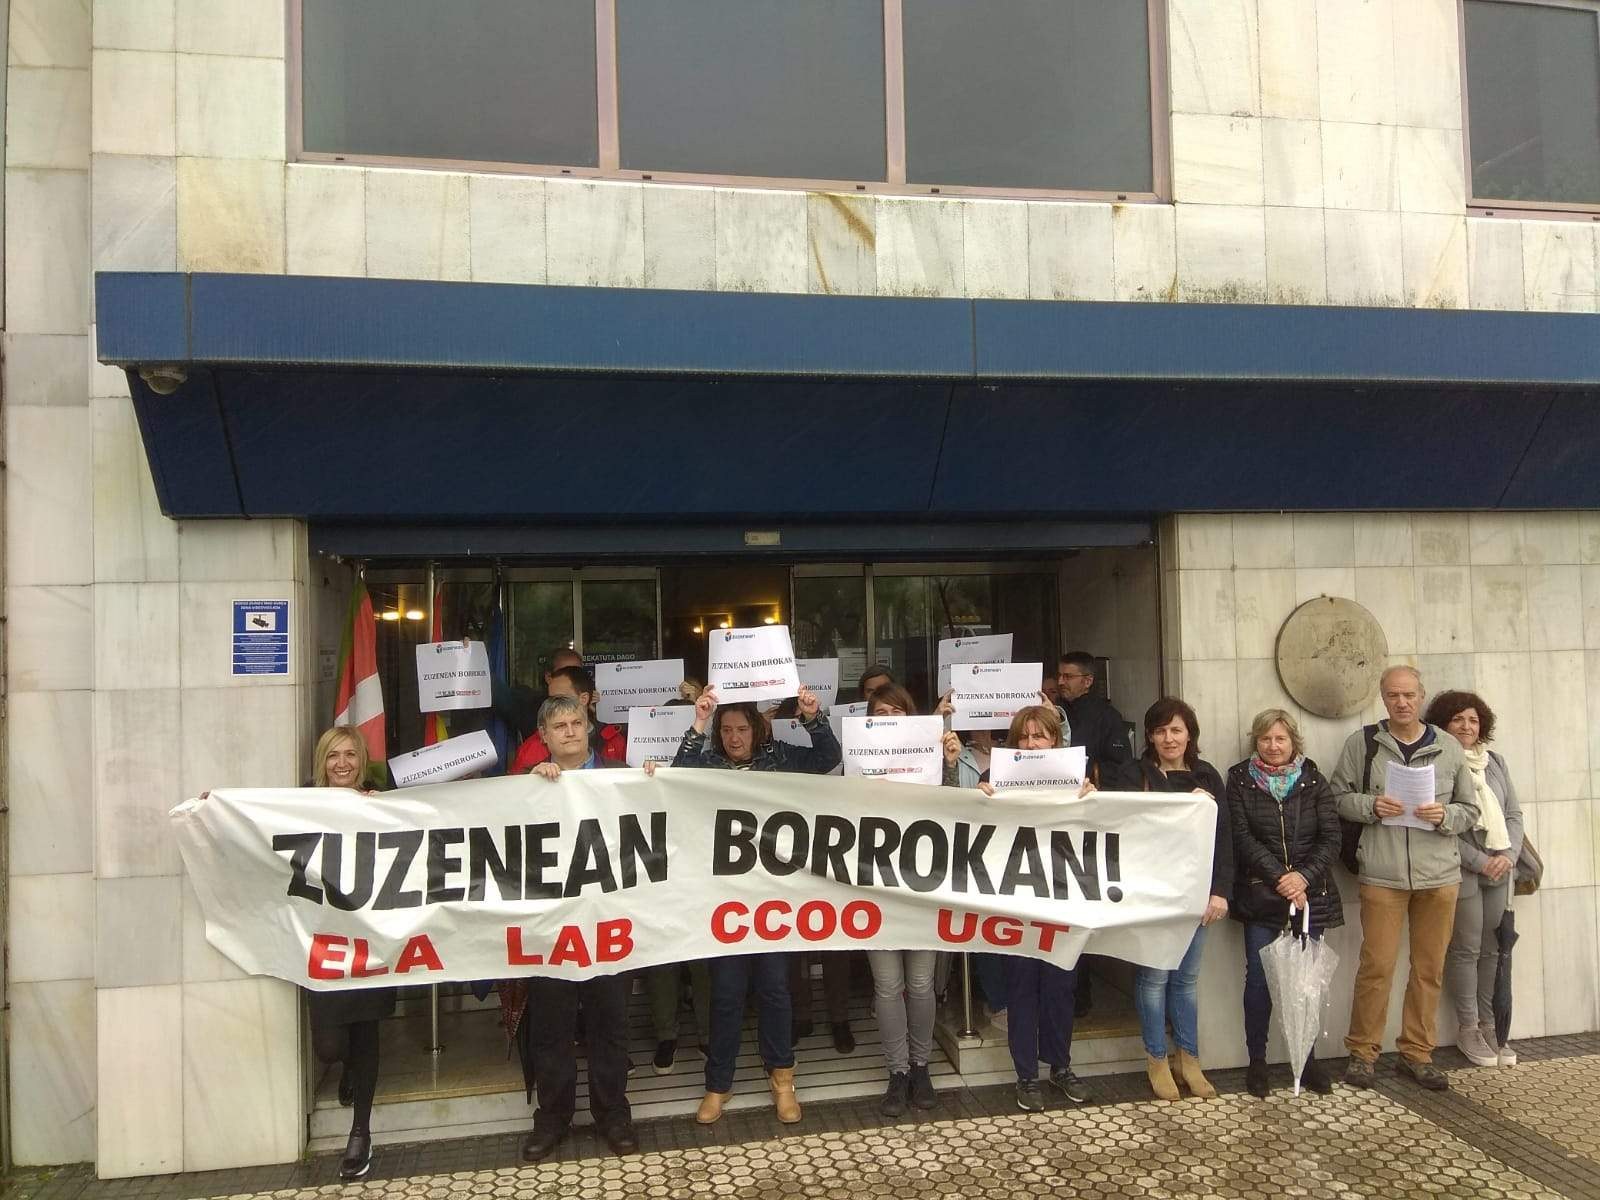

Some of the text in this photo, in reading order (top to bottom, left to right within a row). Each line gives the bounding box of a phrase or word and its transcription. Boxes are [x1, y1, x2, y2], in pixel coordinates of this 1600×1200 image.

[711, 657, 793, 670] ZUZENEAN BORROKAN
[423, 671, 457, 681] ZUZENEAN
[601, 686, 677, 696] ZUZENEAN BORROKAN
[633, 736, 670, 744] ZUZENEAN
[848, 746, 936, 756] ZUZENEAN BORROKAN
[402, 764, 443, 784] ZUZENEAN
[443, 748, 487, 770] BORROKAN
[995, 778, 1080, 787] ZUZENEAN BORROKAN
[272, 809, 1123, 911] ZUZENEAN BORROKAN!
[307, 900, 1070, 980] ELA LAB CCOO UGT
